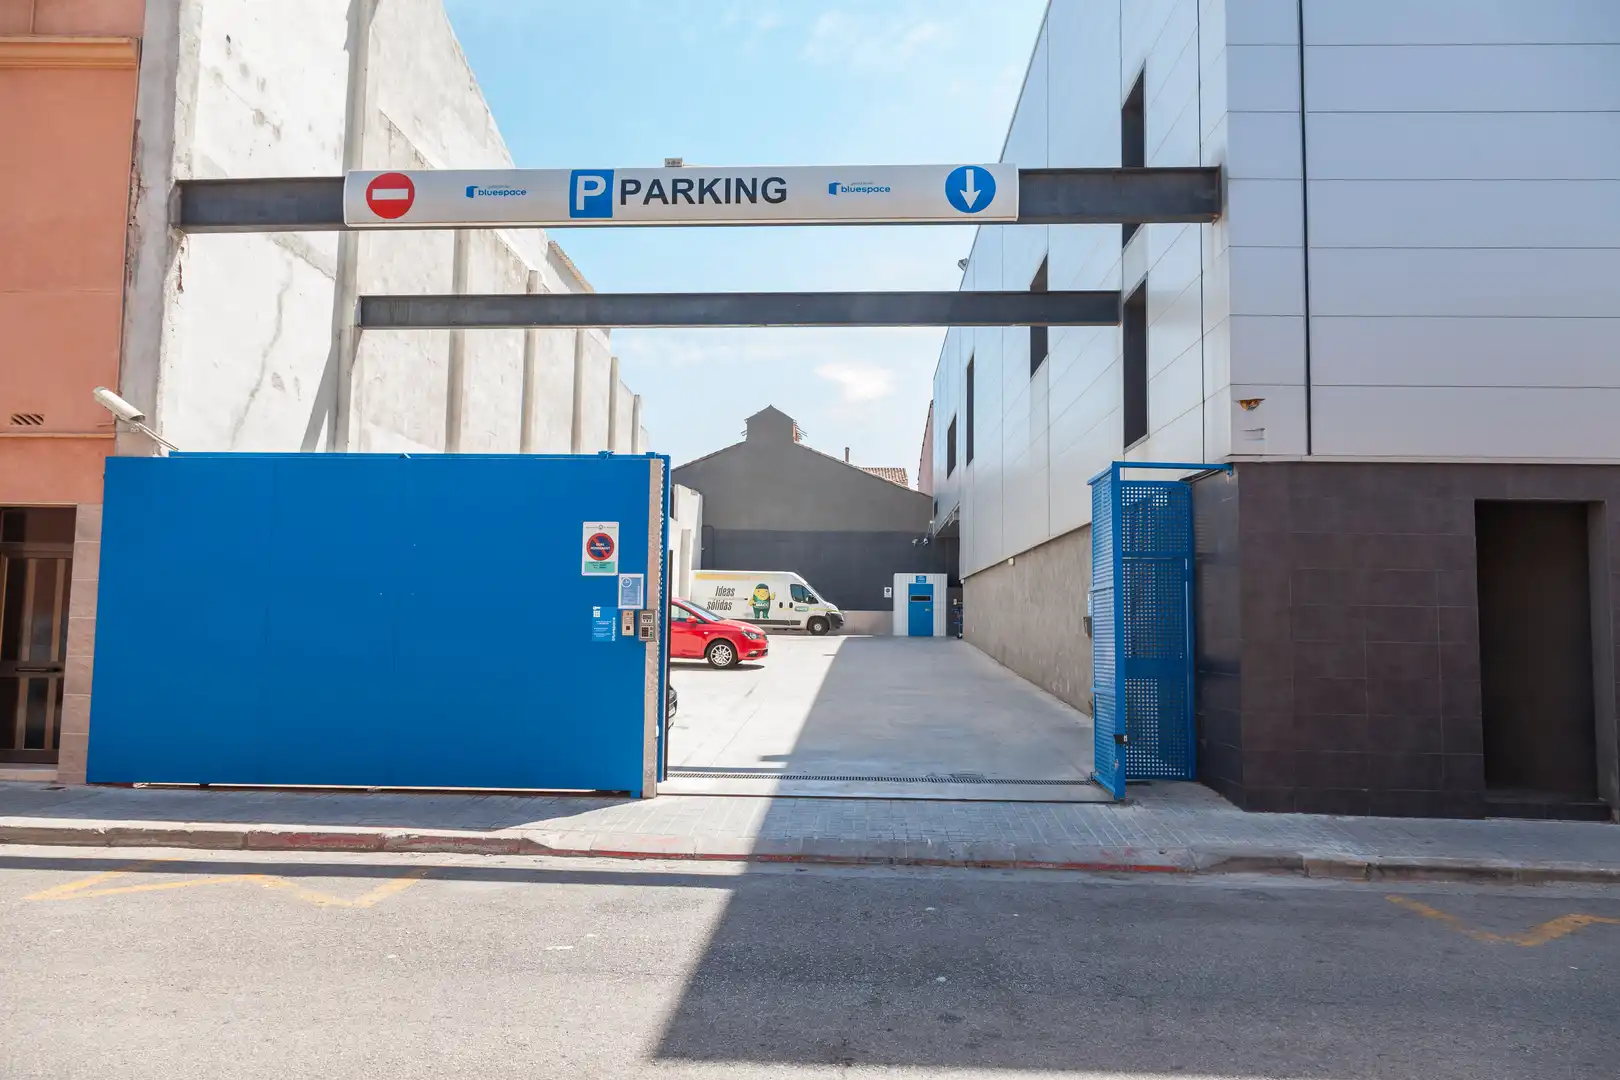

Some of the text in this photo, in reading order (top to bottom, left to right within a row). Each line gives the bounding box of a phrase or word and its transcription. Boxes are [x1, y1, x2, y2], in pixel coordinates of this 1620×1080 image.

[478, 188, 527, 197] bluespace
[576, 175, 787, 210] P PARKING
[841, 185, 891, 194] bluespace
[715, 585, 736, 597] Ideas
[706, 599, 733, 611] sólidas
